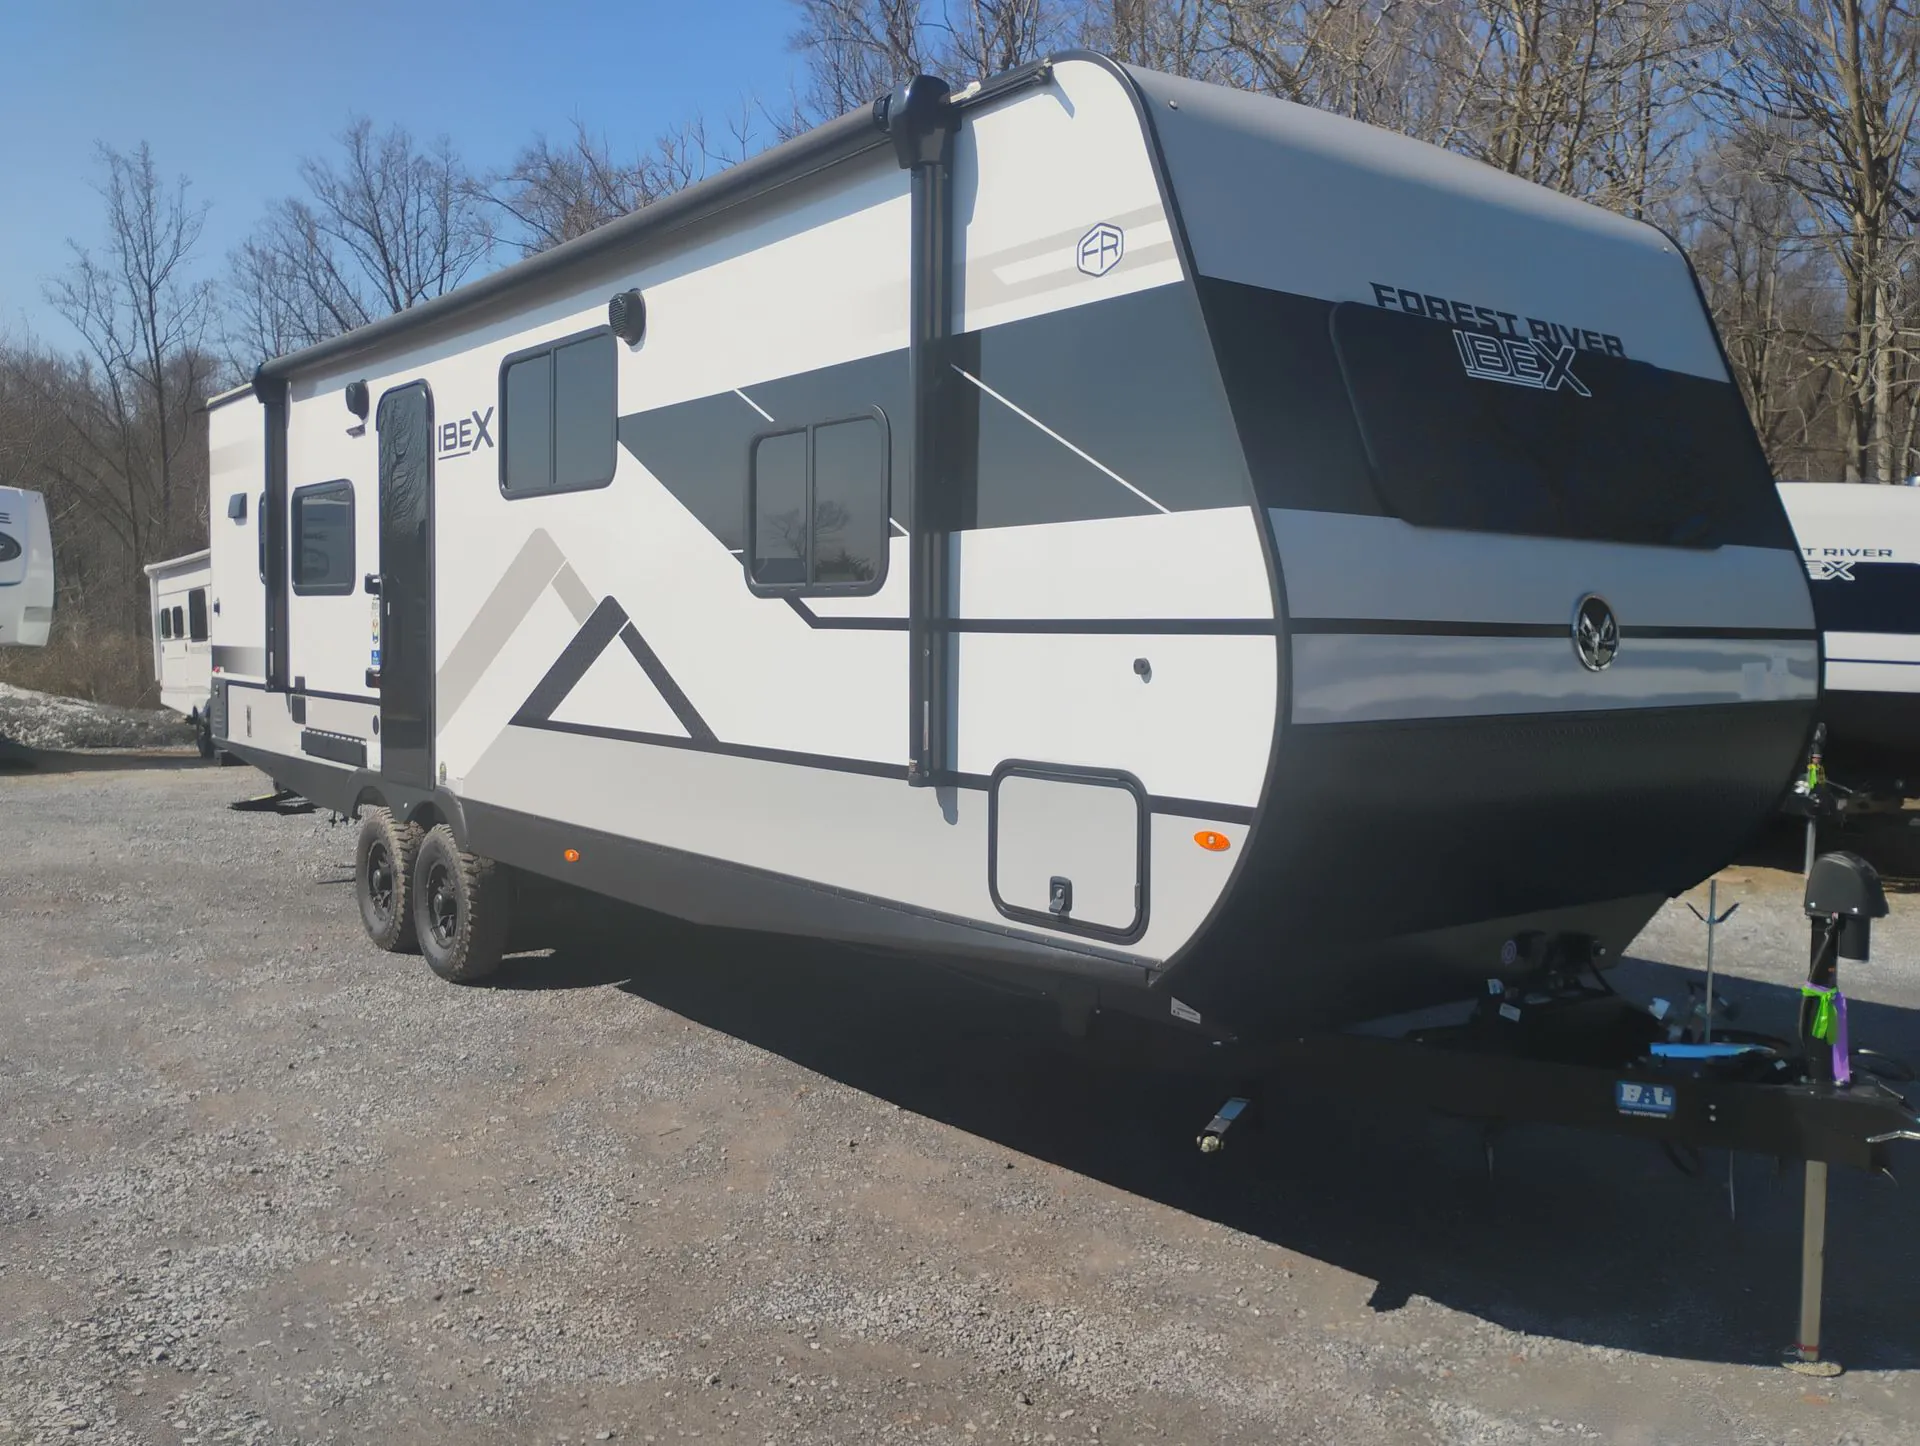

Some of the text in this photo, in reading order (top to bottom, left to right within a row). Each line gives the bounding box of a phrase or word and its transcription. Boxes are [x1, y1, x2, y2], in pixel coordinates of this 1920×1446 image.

[1369, 282, 1629, 359] FOREST RIVER
[1452, 329, 1592, 397] IBEX
[438, 406, 495, 453] IBEX
[1823, 548, 1893, 557] RIVER
